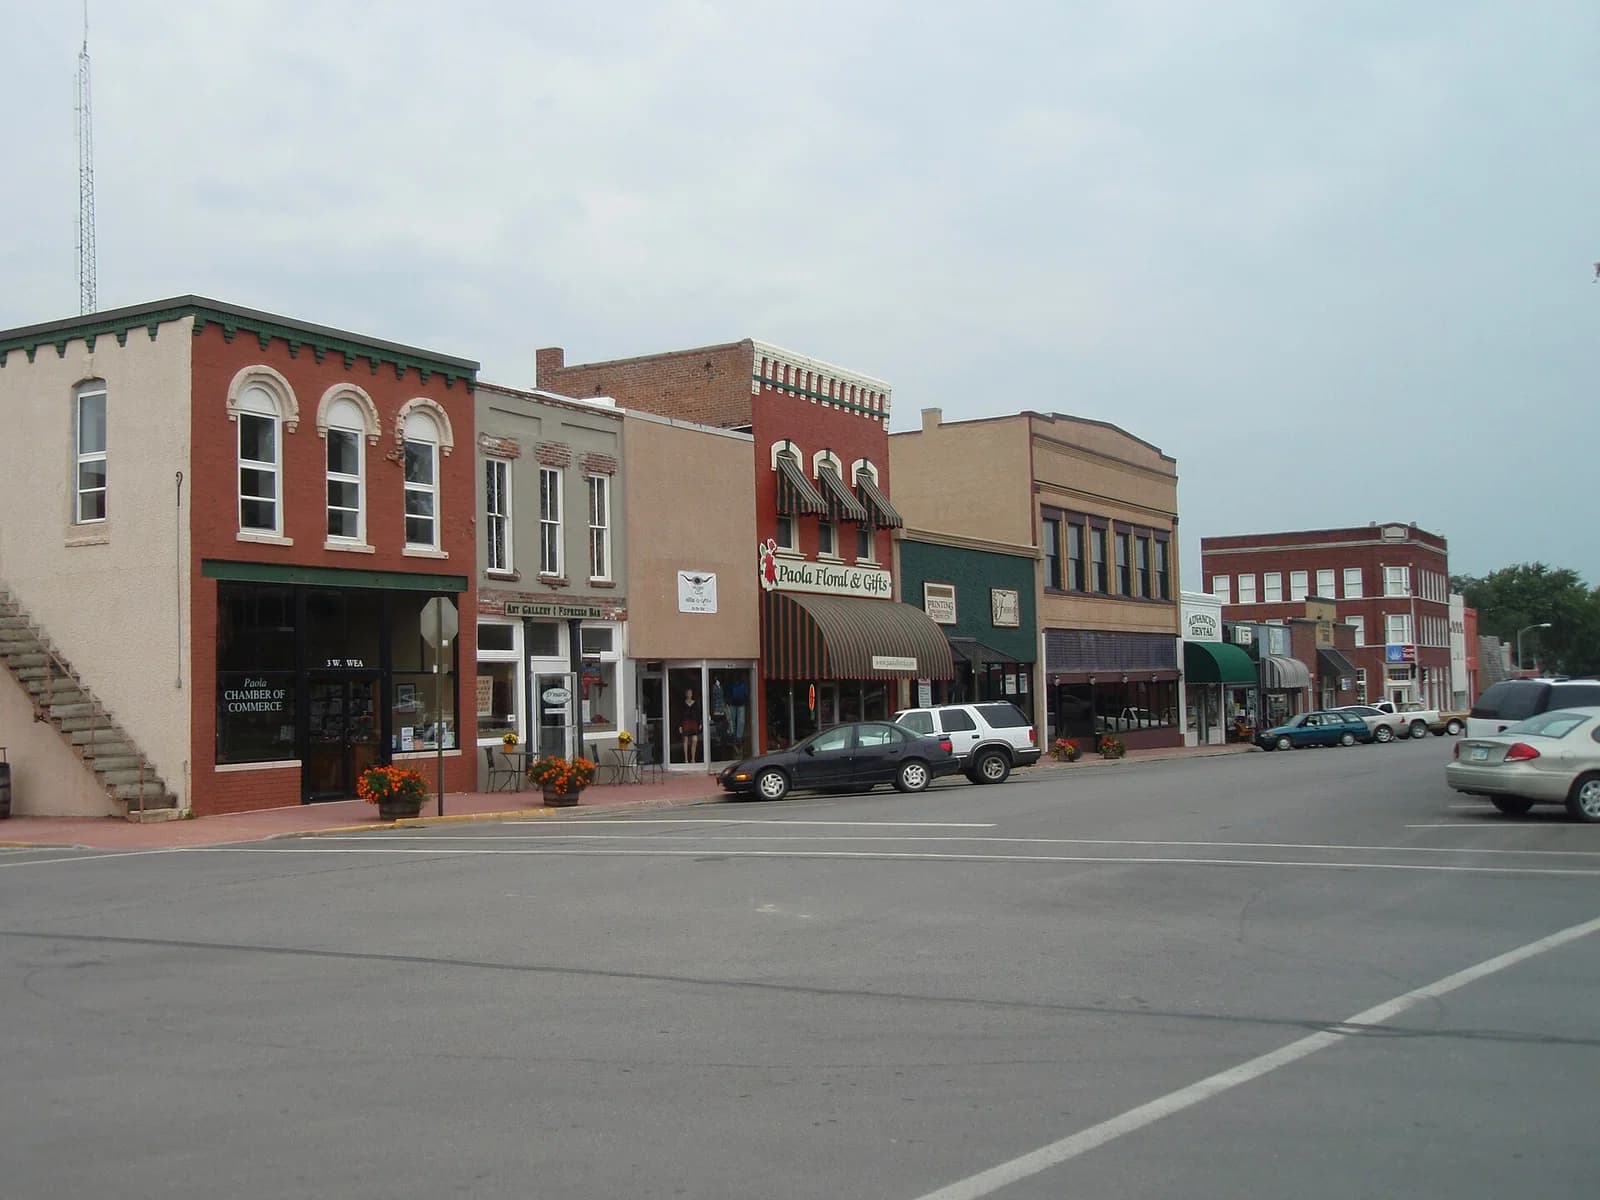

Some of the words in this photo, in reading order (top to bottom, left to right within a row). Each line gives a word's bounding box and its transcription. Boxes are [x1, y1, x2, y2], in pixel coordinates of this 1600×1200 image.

[778, 565, 812, 585] Paola
[815, 567, 849, 588] Floral
[850, 573, 861, 589] &
[863, 573, 888, 594] Gifts
[927, 600, 954, 611] PRINTING
[1188, 614, 1217, 628] ADVANCED
[1191, 626, 1214, 637] DENTAL
[326, 659, 331, 667] 3
[346, 659, 364, 668] WEA
[244, 678, 268, 688] Paola
[224, 689, 272, 700] CHAMBER
[273, 689, 286, 700] OF
[228, 701, 283, 713] COMMERCE
